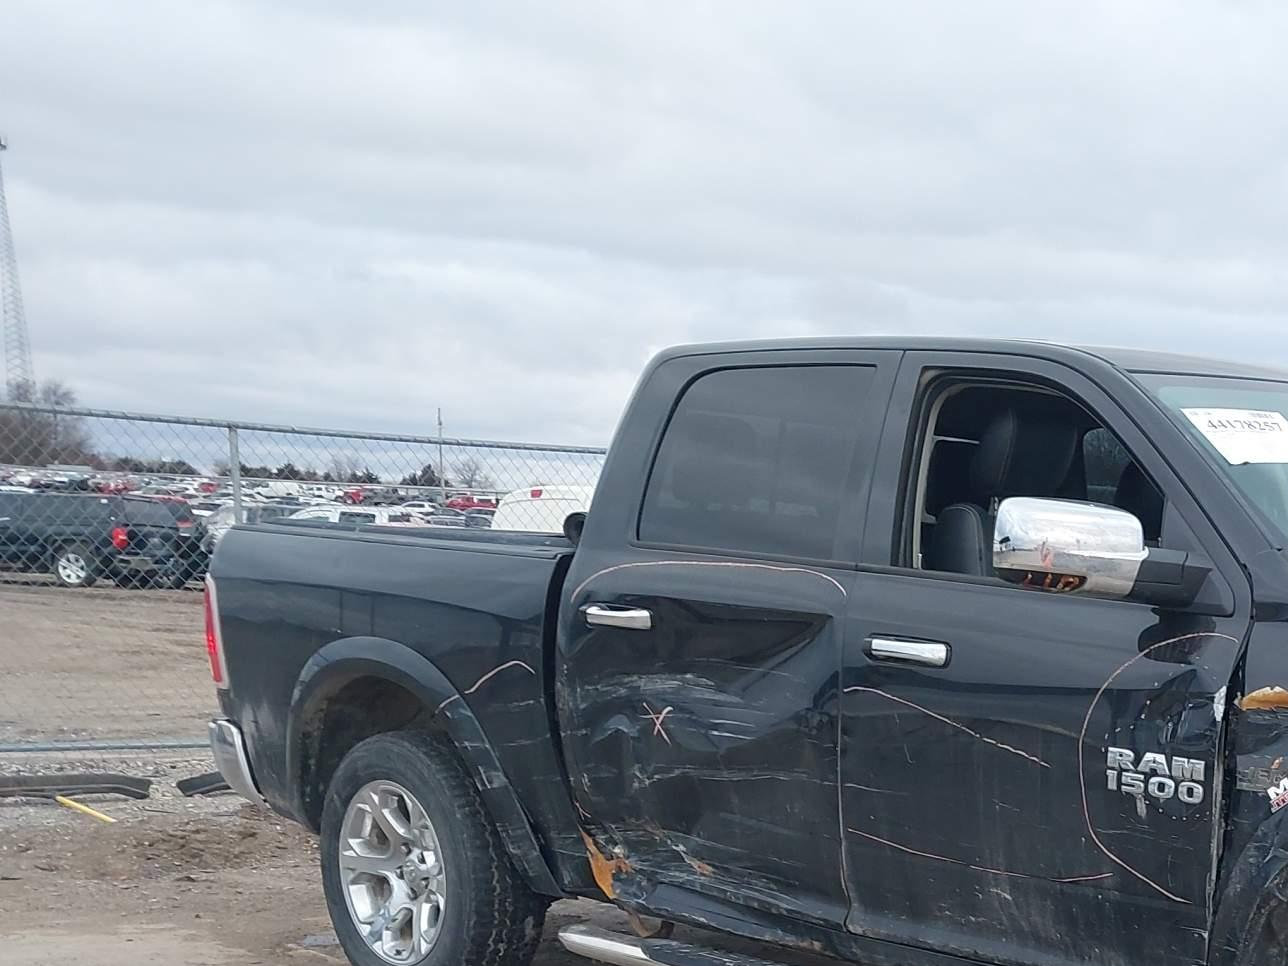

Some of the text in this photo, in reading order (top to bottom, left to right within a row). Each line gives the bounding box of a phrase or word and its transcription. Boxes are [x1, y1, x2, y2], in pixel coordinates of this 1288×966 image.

[1207, 419, 1283, 432] 44178257
[1106, 746, 1206, 782] RAM
[1106, 769, 1205, 805] 1500
